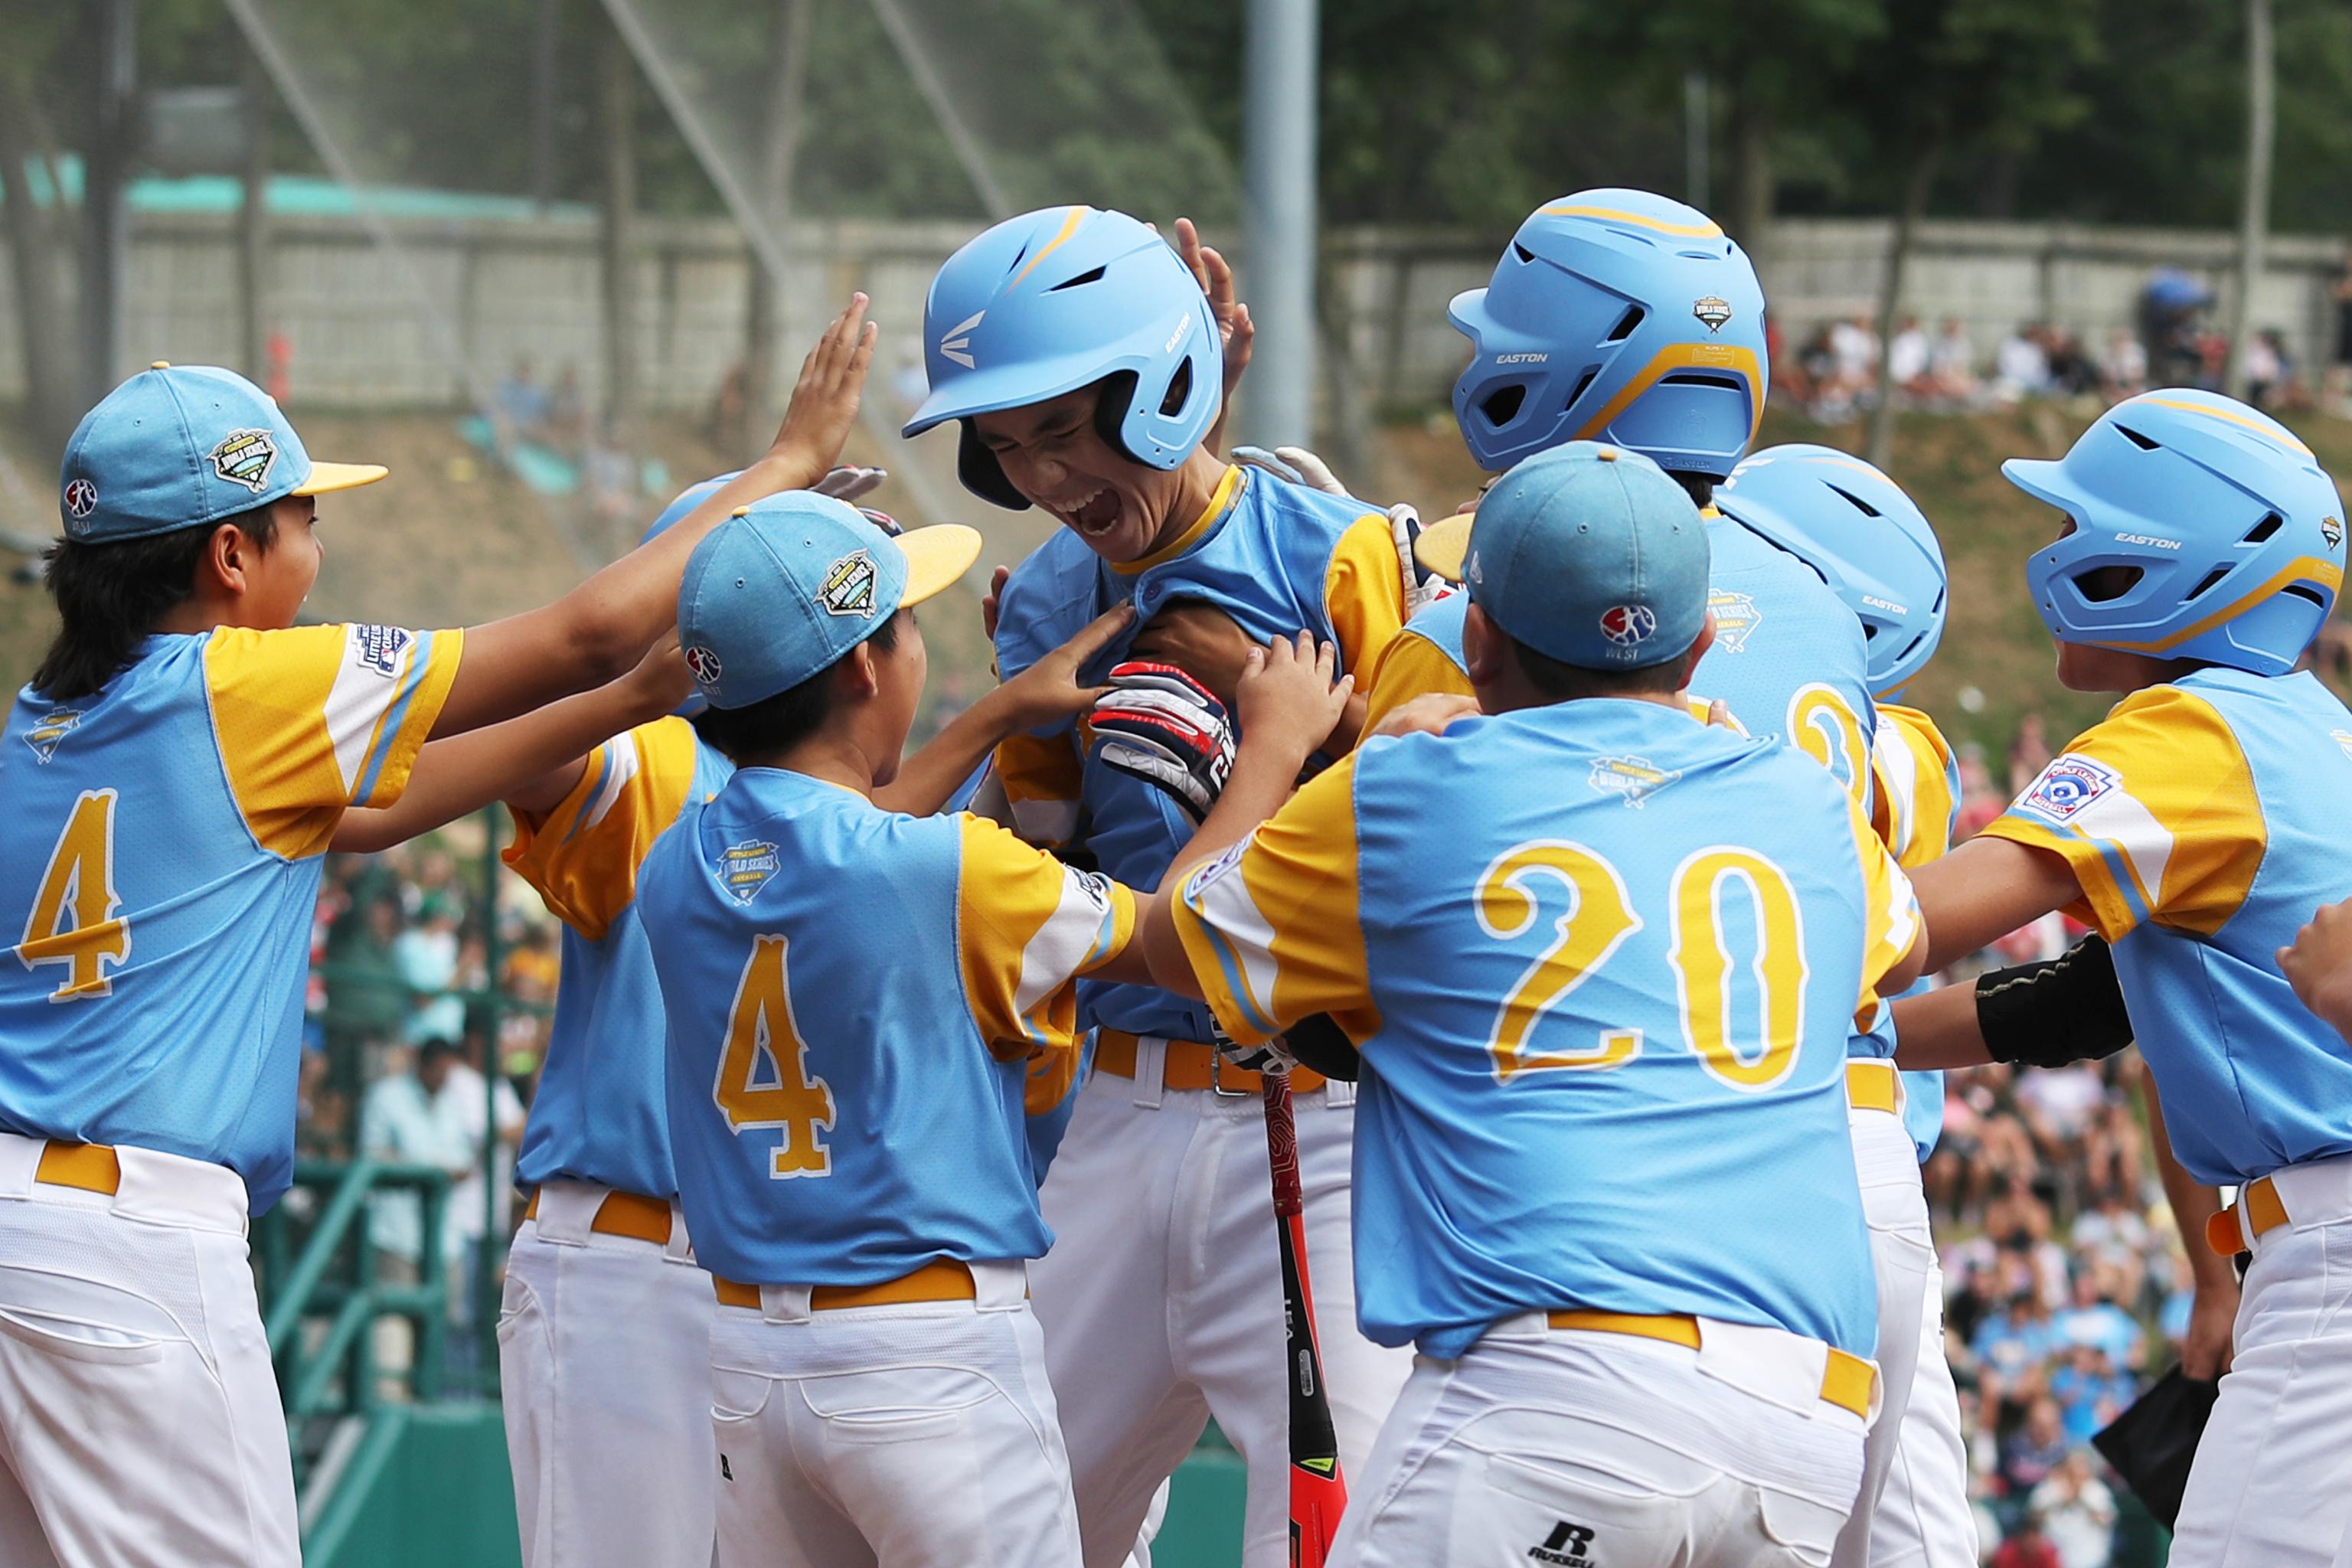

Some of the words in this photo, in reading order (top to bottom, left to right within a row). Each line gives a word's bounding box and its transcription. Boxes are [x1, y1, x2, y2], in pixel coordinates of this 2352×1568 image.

[1165, 311, 1191, 354] EASTON
[1496, 354, 1548, 364] EASTON
[220, 449, 245, 470] WORLD
[243, 440, 268, 459] SERIES
[2115, 532, 2181, 550] EASTON
[828, 580, 852, 606] WORLD
[846, 563, 871, 587] SERIES
[1862, 595, 1908, 615] EASTON
[1606, 648, 1638, 661] WEST
[12, 788, 132, 1004] 4
[1474, 838, 1811, 1093] 20
[713, 933, 837, 1179] 4
[1543, 1520, 1595, 1557] R
[1527, 1547, 1595, 1568] RUSSELL
